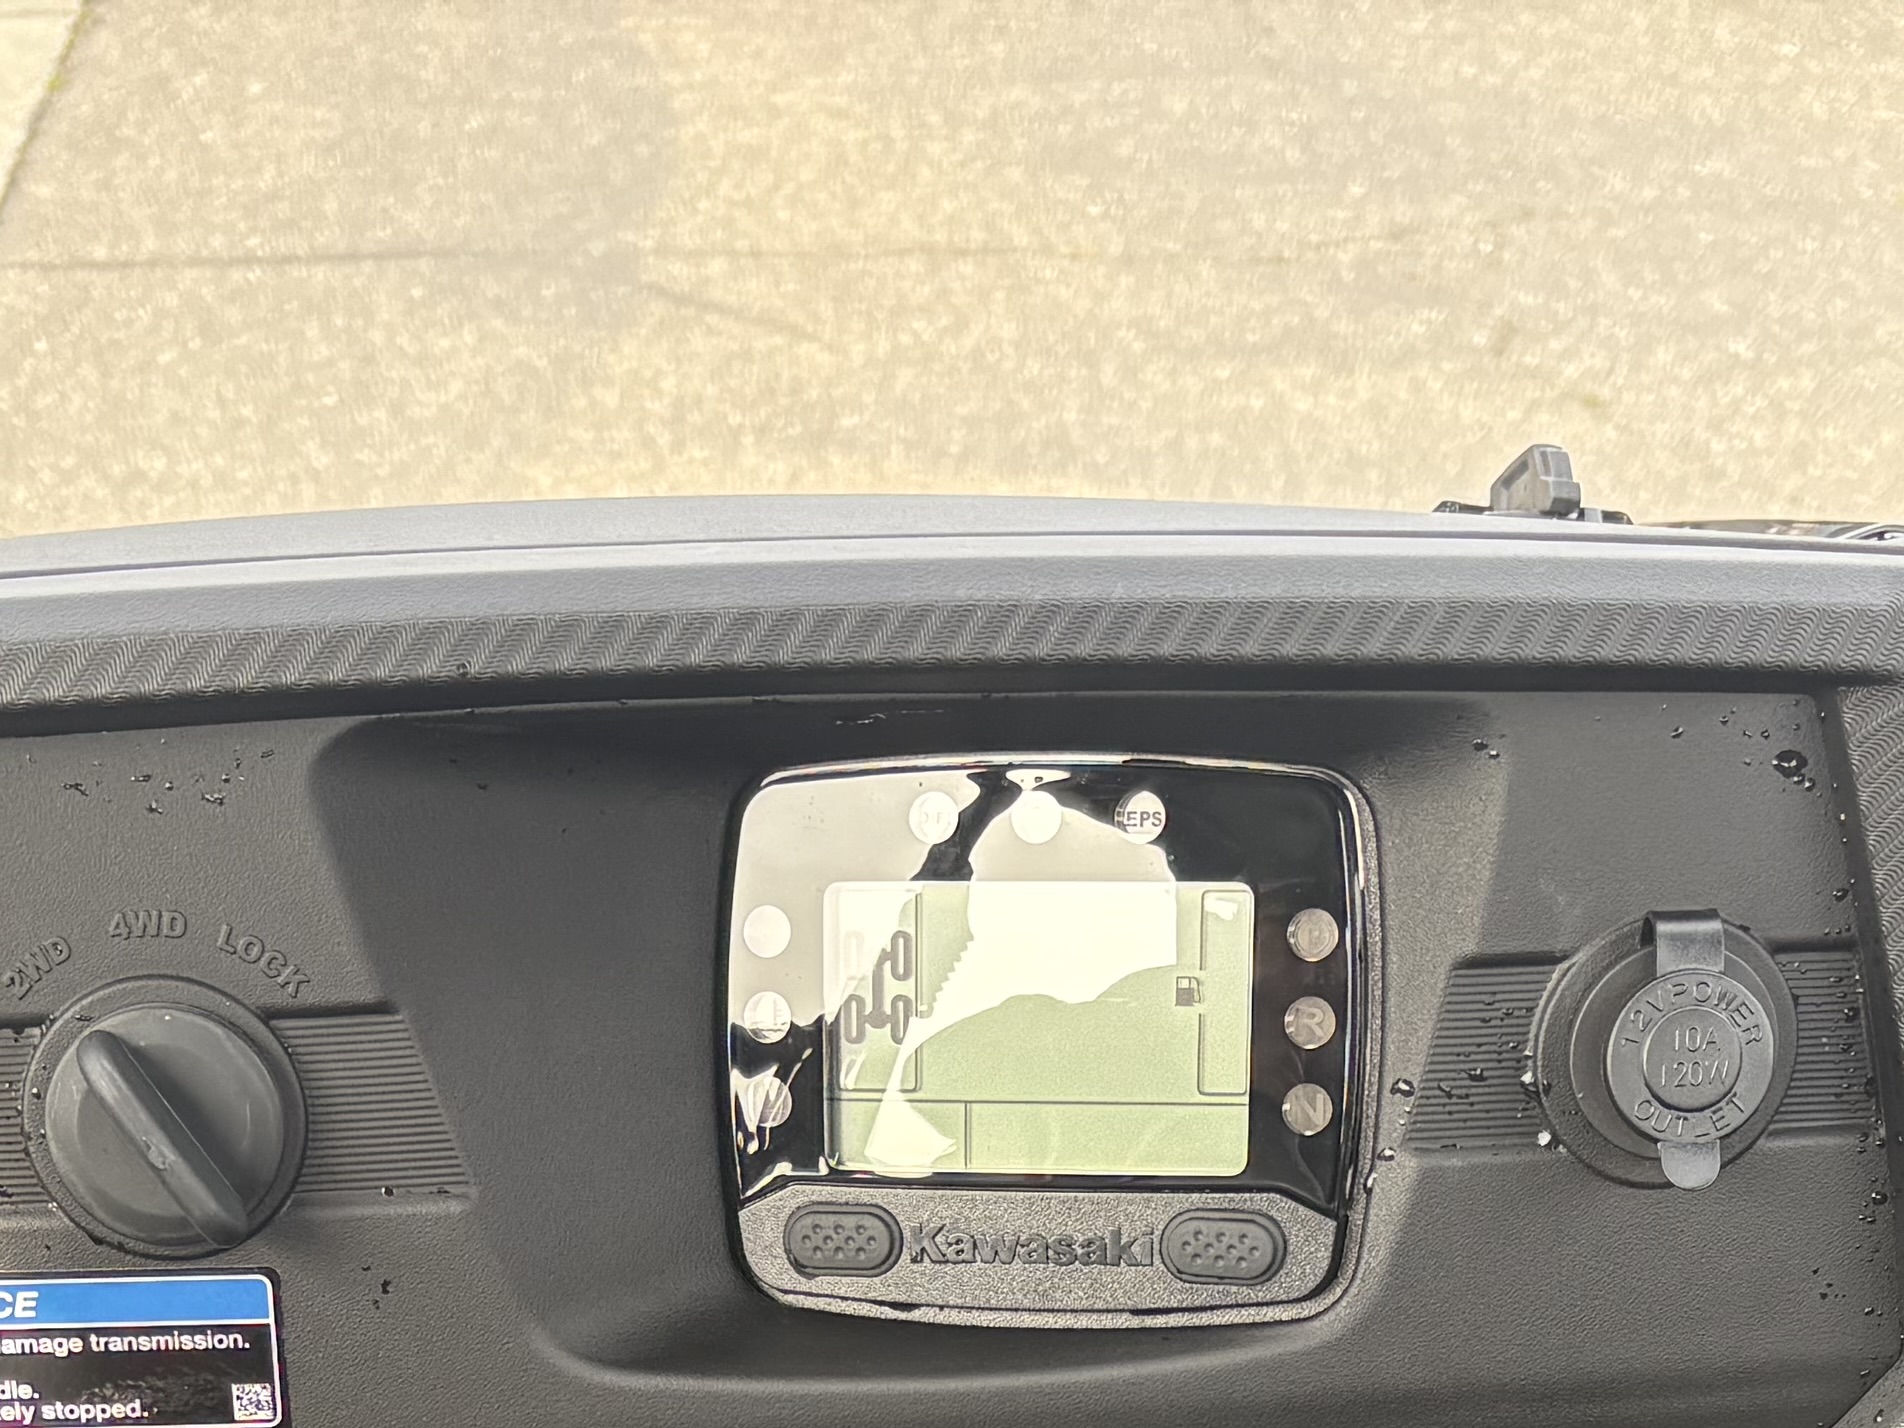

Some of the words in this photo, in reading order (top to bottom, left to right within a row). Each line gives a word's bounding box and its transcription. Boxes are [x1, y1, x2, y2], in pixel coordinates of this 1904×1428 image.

[1123, 811, 1163, 828] EPS
[108, 909, 187, 940] 4WD
[4, 935, 73, 1001] 2WD
[217, 925, 310, 999] LOCK
[1673, 1026, 1721, 1052] 10A
[1633, 1090, 1747, 1138] OUTLET
[909, 1224, 1157, 1268] Kawasaki
[89, 1333, 251, 1353] transmission.
[41, 1399, 149, 1424] stopped.
